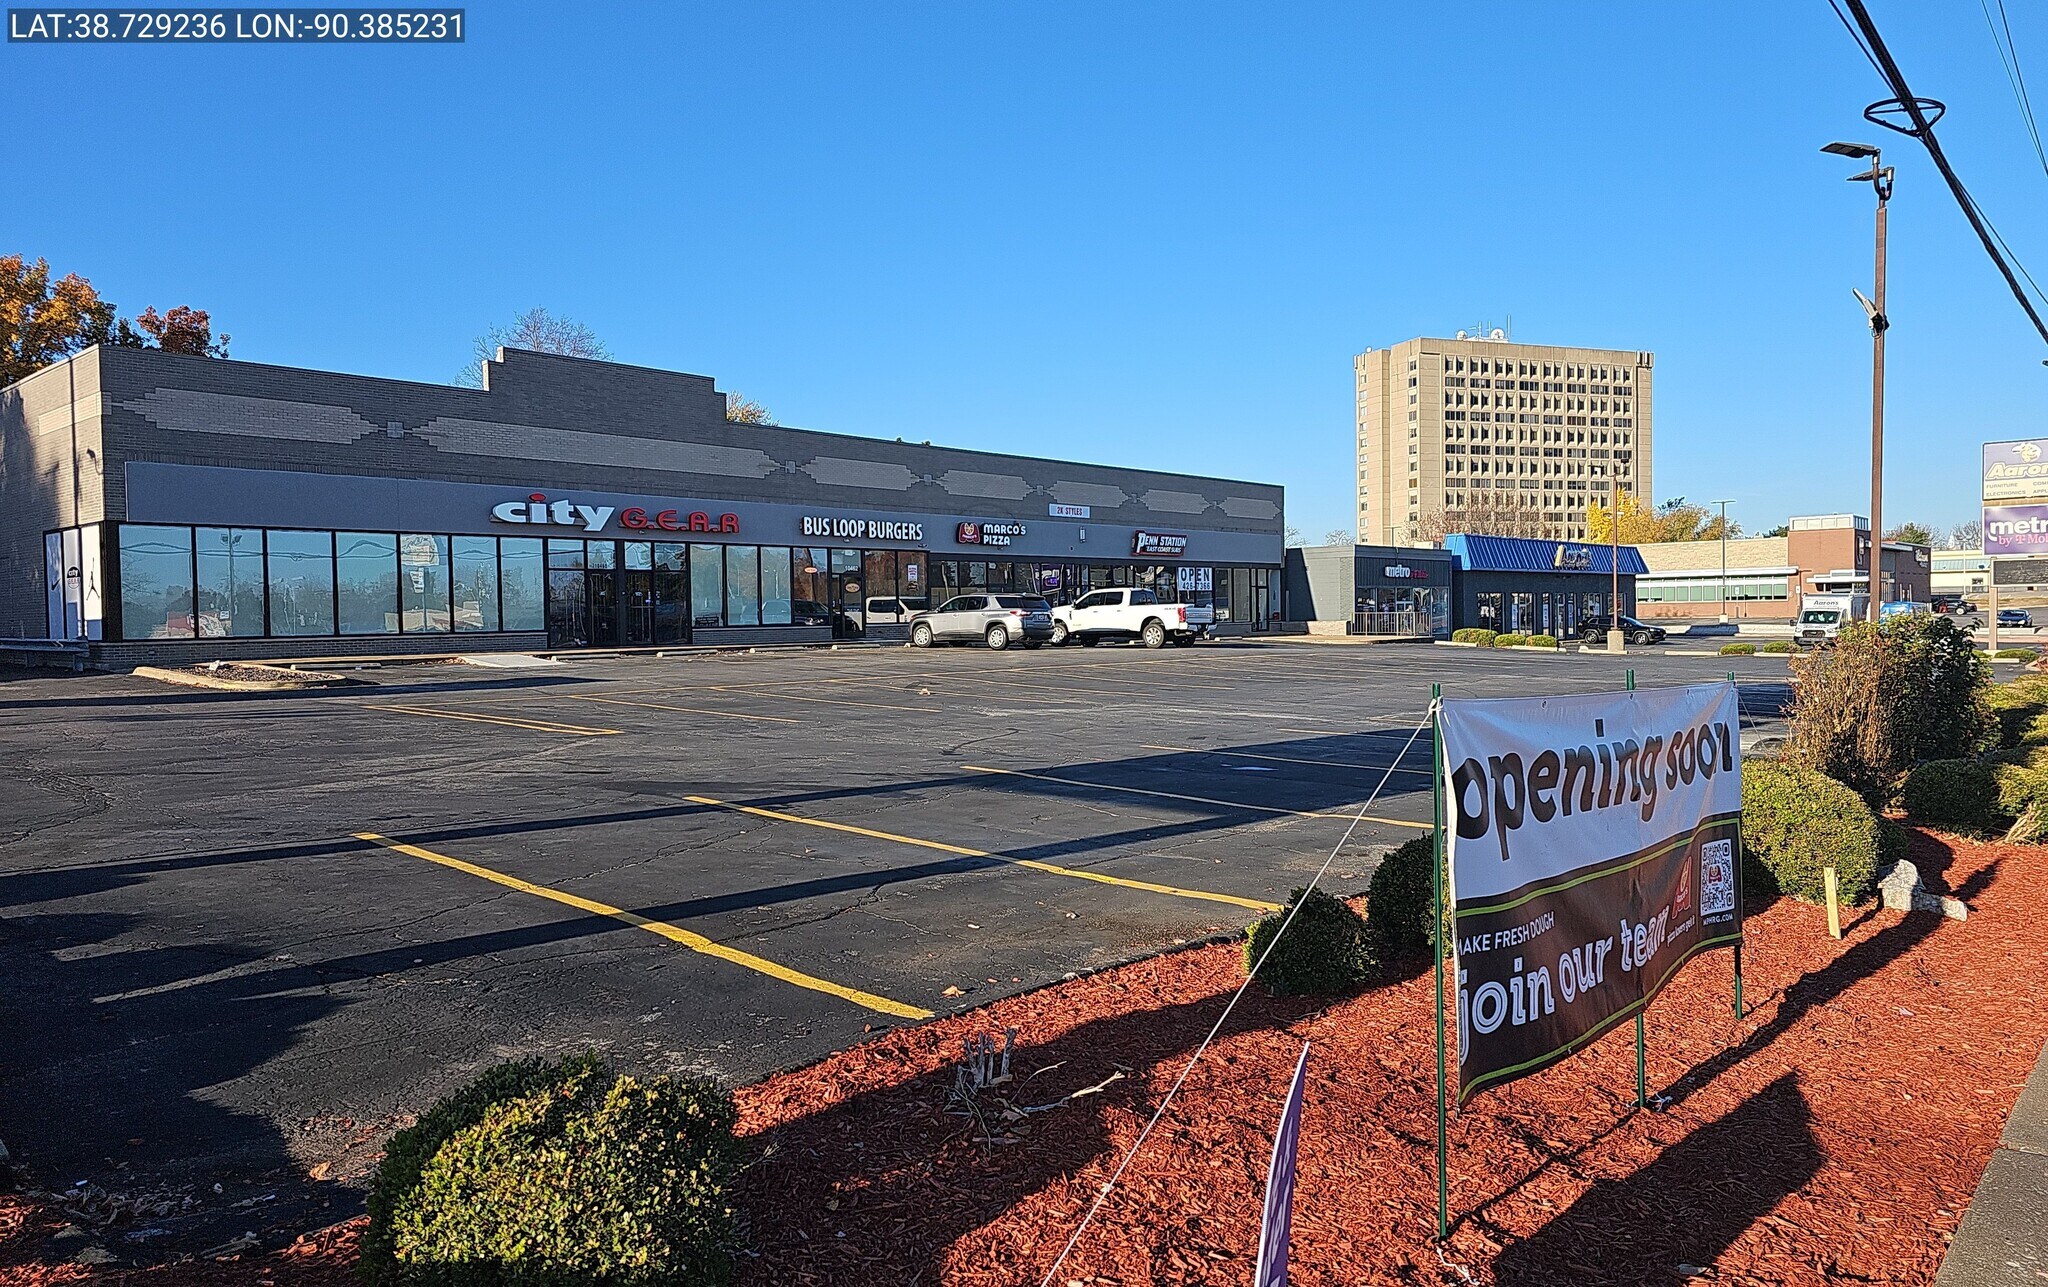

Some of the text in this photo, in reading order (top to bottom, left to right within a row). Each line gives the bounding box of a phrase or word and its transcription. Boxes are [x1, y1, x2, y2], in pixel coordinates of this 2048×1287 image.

[1986, 489, 2026, 497] ELECTRONICS
[491, 492, 615, 532] city
[1056, 506, 1083, 516] 2K STYLES
[803, 516, 923, 541] BUS LOOP BURGERS
[983, 523, 1027, 535] MARCO'S
[983, 535, 1011, 546] PIZZA
[1136, 532, 1187, 553] PENN STATION
[1998, 535, 2013, 547] by
[1180, 567, 1210, 582] OPEN
[1384, 564, 1411, 578] metro
[1451, 718, 1733, 862] opening soon
[1494, 922, 1530, 949] FRESH
[1530, 910, 1555, 939] DOUGH
[1459, 904, 1670, 1067] join our team
